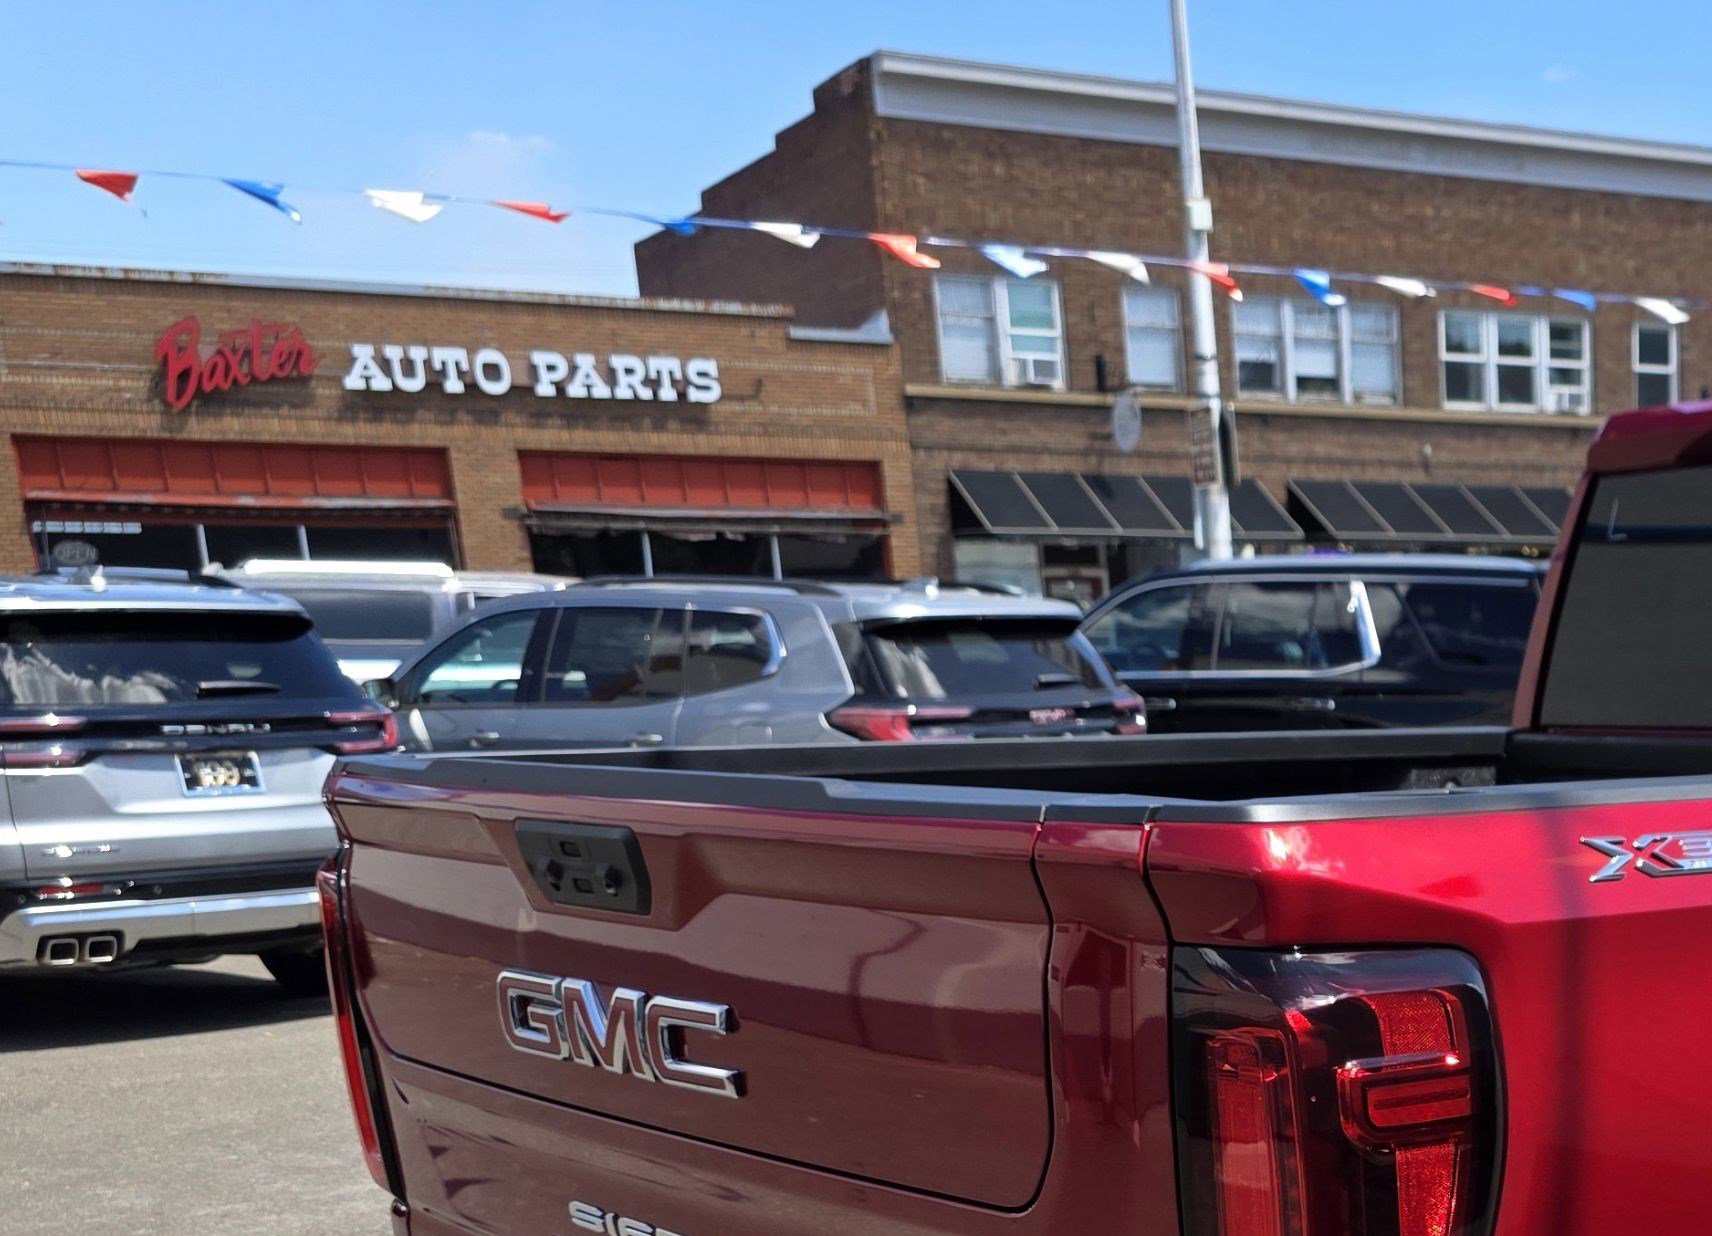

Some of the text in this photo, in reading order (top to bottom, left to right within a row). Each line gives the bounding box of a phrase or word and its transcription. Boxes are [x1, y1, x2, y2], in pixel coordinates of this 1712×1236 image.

[155, 315, 320, 410] Baxter
[342, 343, 722, 404] AUTO PARTS
[55, 546, 97, 560] OPEN
[497, 968, 746, 1099] GMC
